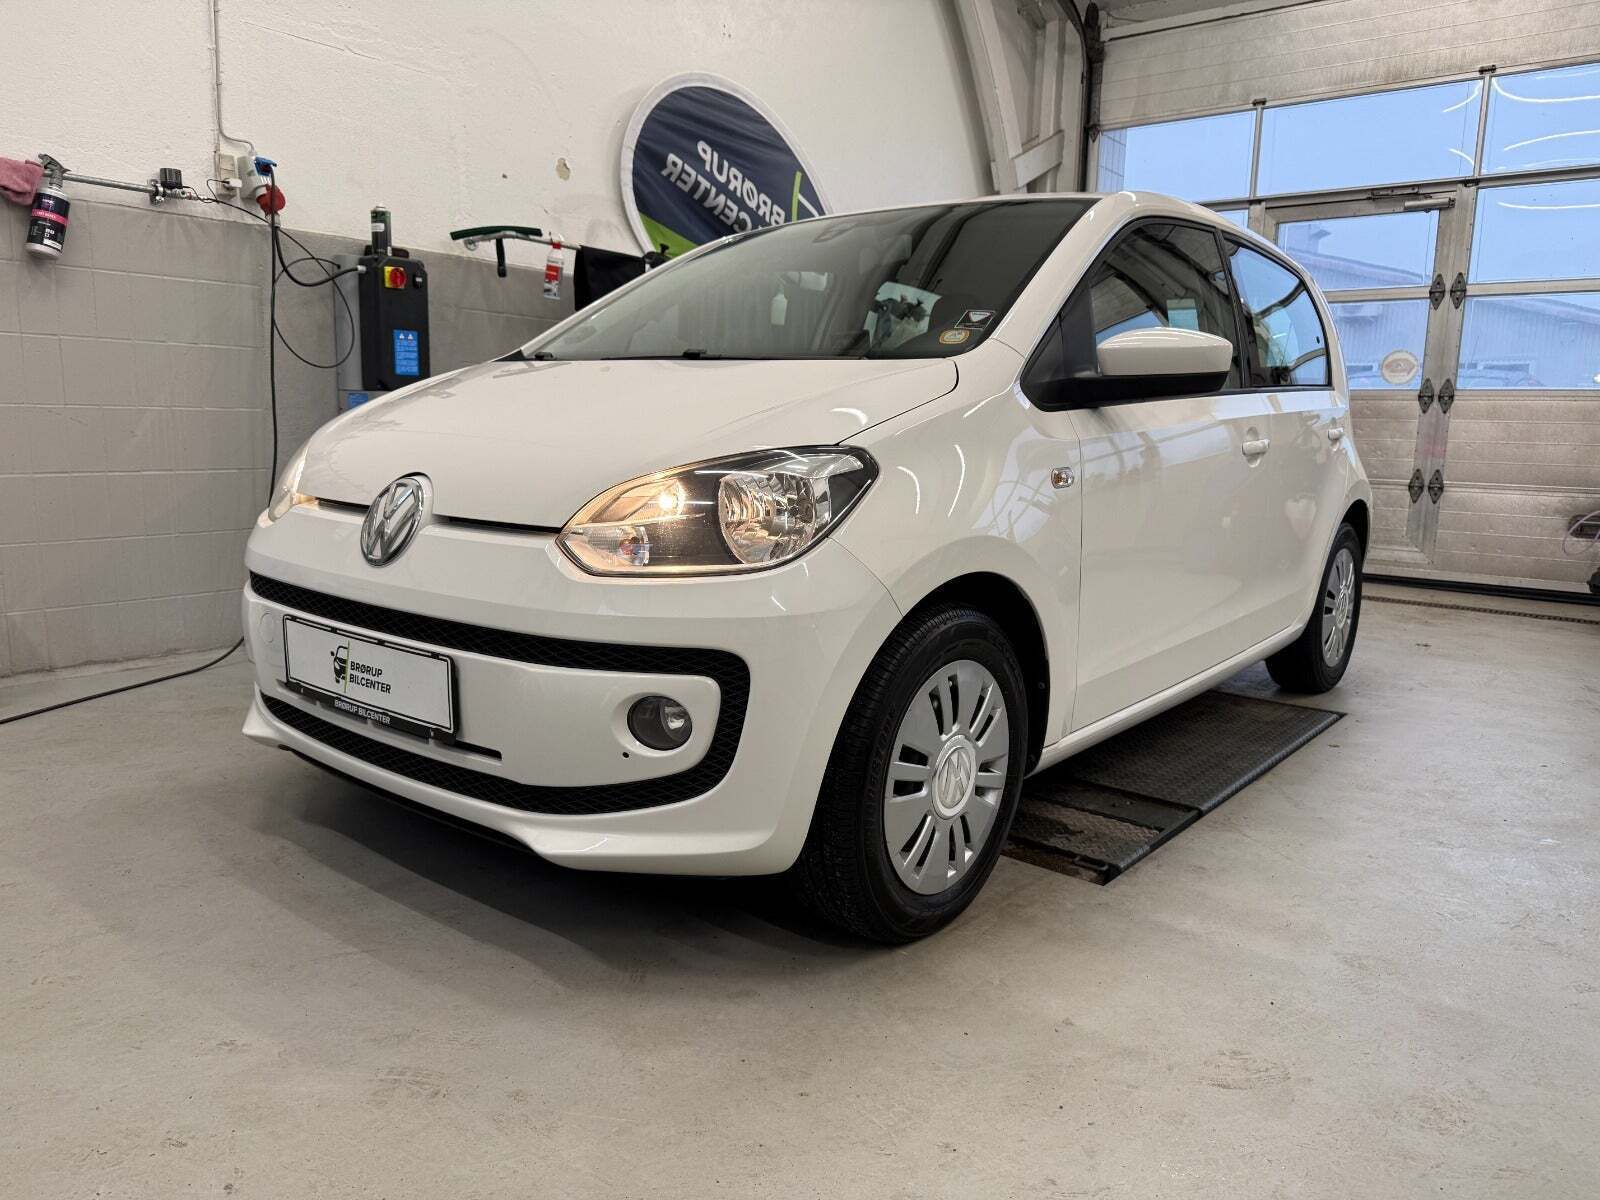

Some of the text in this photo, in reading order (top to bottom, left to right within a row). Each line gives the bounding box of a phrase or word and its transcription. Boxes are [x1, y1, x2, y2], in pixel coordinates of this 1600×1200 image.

[350, 661, 383, 678] BRØRUP
[349, 674, 391, 694] BILCENTER
[334, 699, 391, 724] BRØRUP BILCENTER
